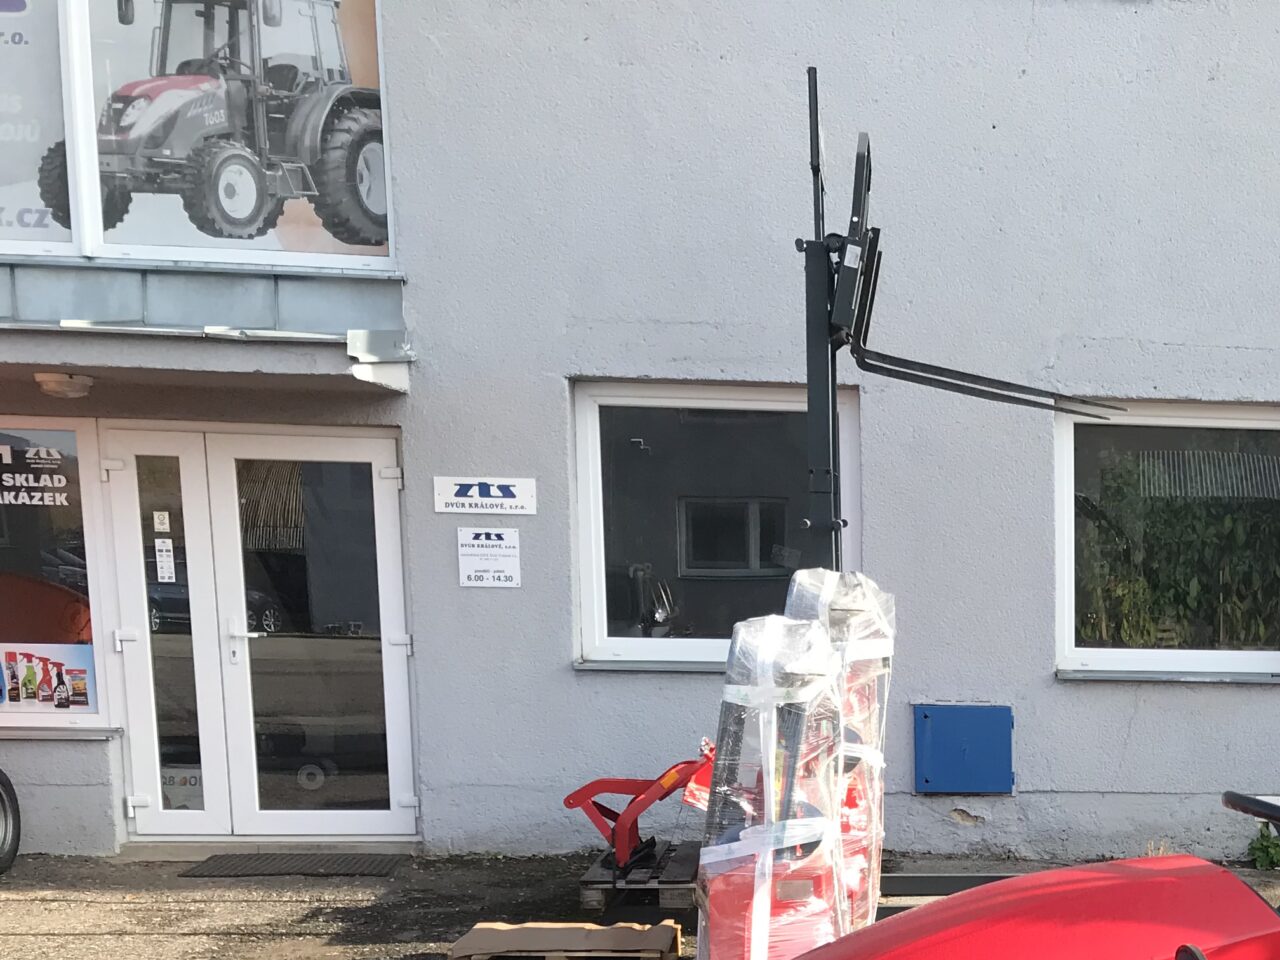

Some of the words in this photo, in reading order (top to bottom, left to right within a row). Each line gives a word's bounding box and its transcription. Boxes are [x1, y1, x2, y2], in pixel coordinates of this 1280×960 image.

[2, 473, 67, 488] SKLAD
[454, 482, 516, 498] zts
[445, 501, 466, 509] DVŮR
[472, 532, 504, 541] zts
[467, 574, 485, 582] 6.00
[491, 575, 513, 583] 14.30
